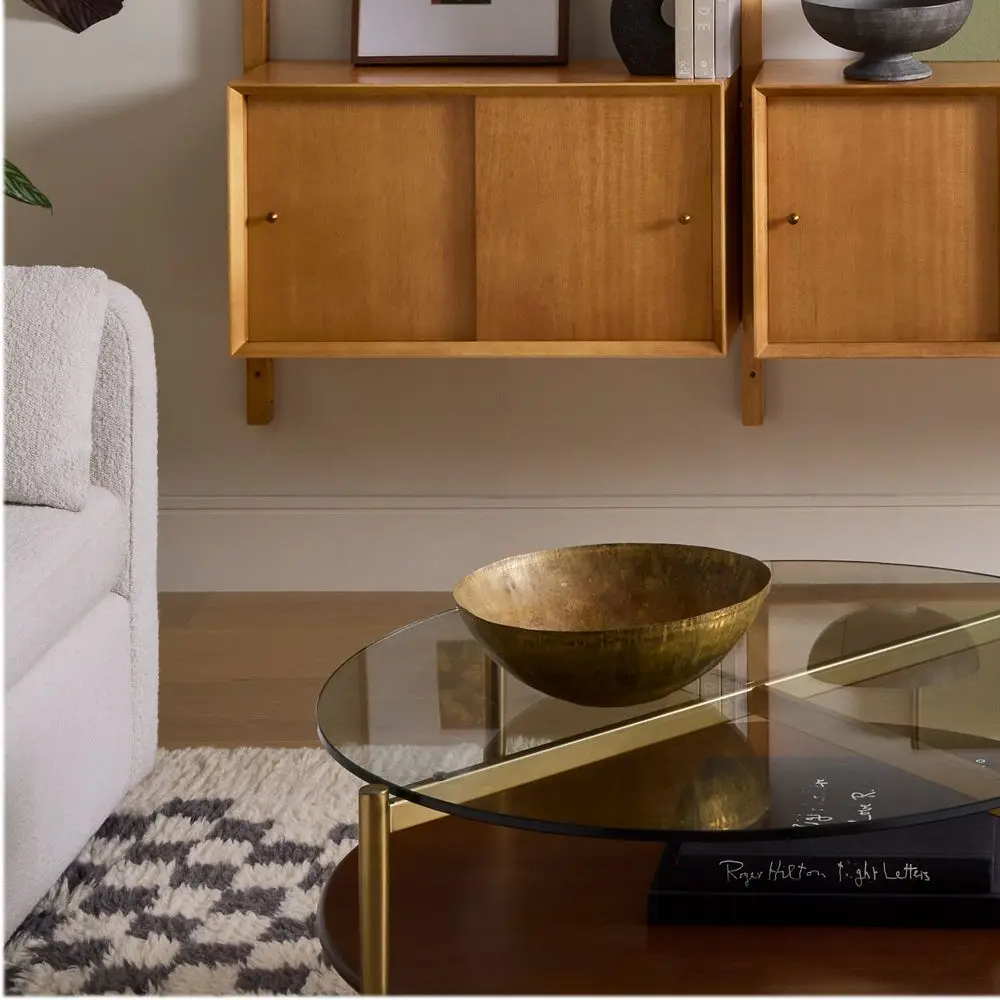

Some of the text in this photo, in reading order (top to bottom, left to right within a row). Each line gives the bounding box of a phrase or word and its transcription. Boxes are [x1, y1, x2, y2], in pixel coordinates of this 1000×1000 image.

[719, 860, 763, 887] Roger
[768, 859, 826, 881] Hilton
[883, 861, 931, 882] Letters
